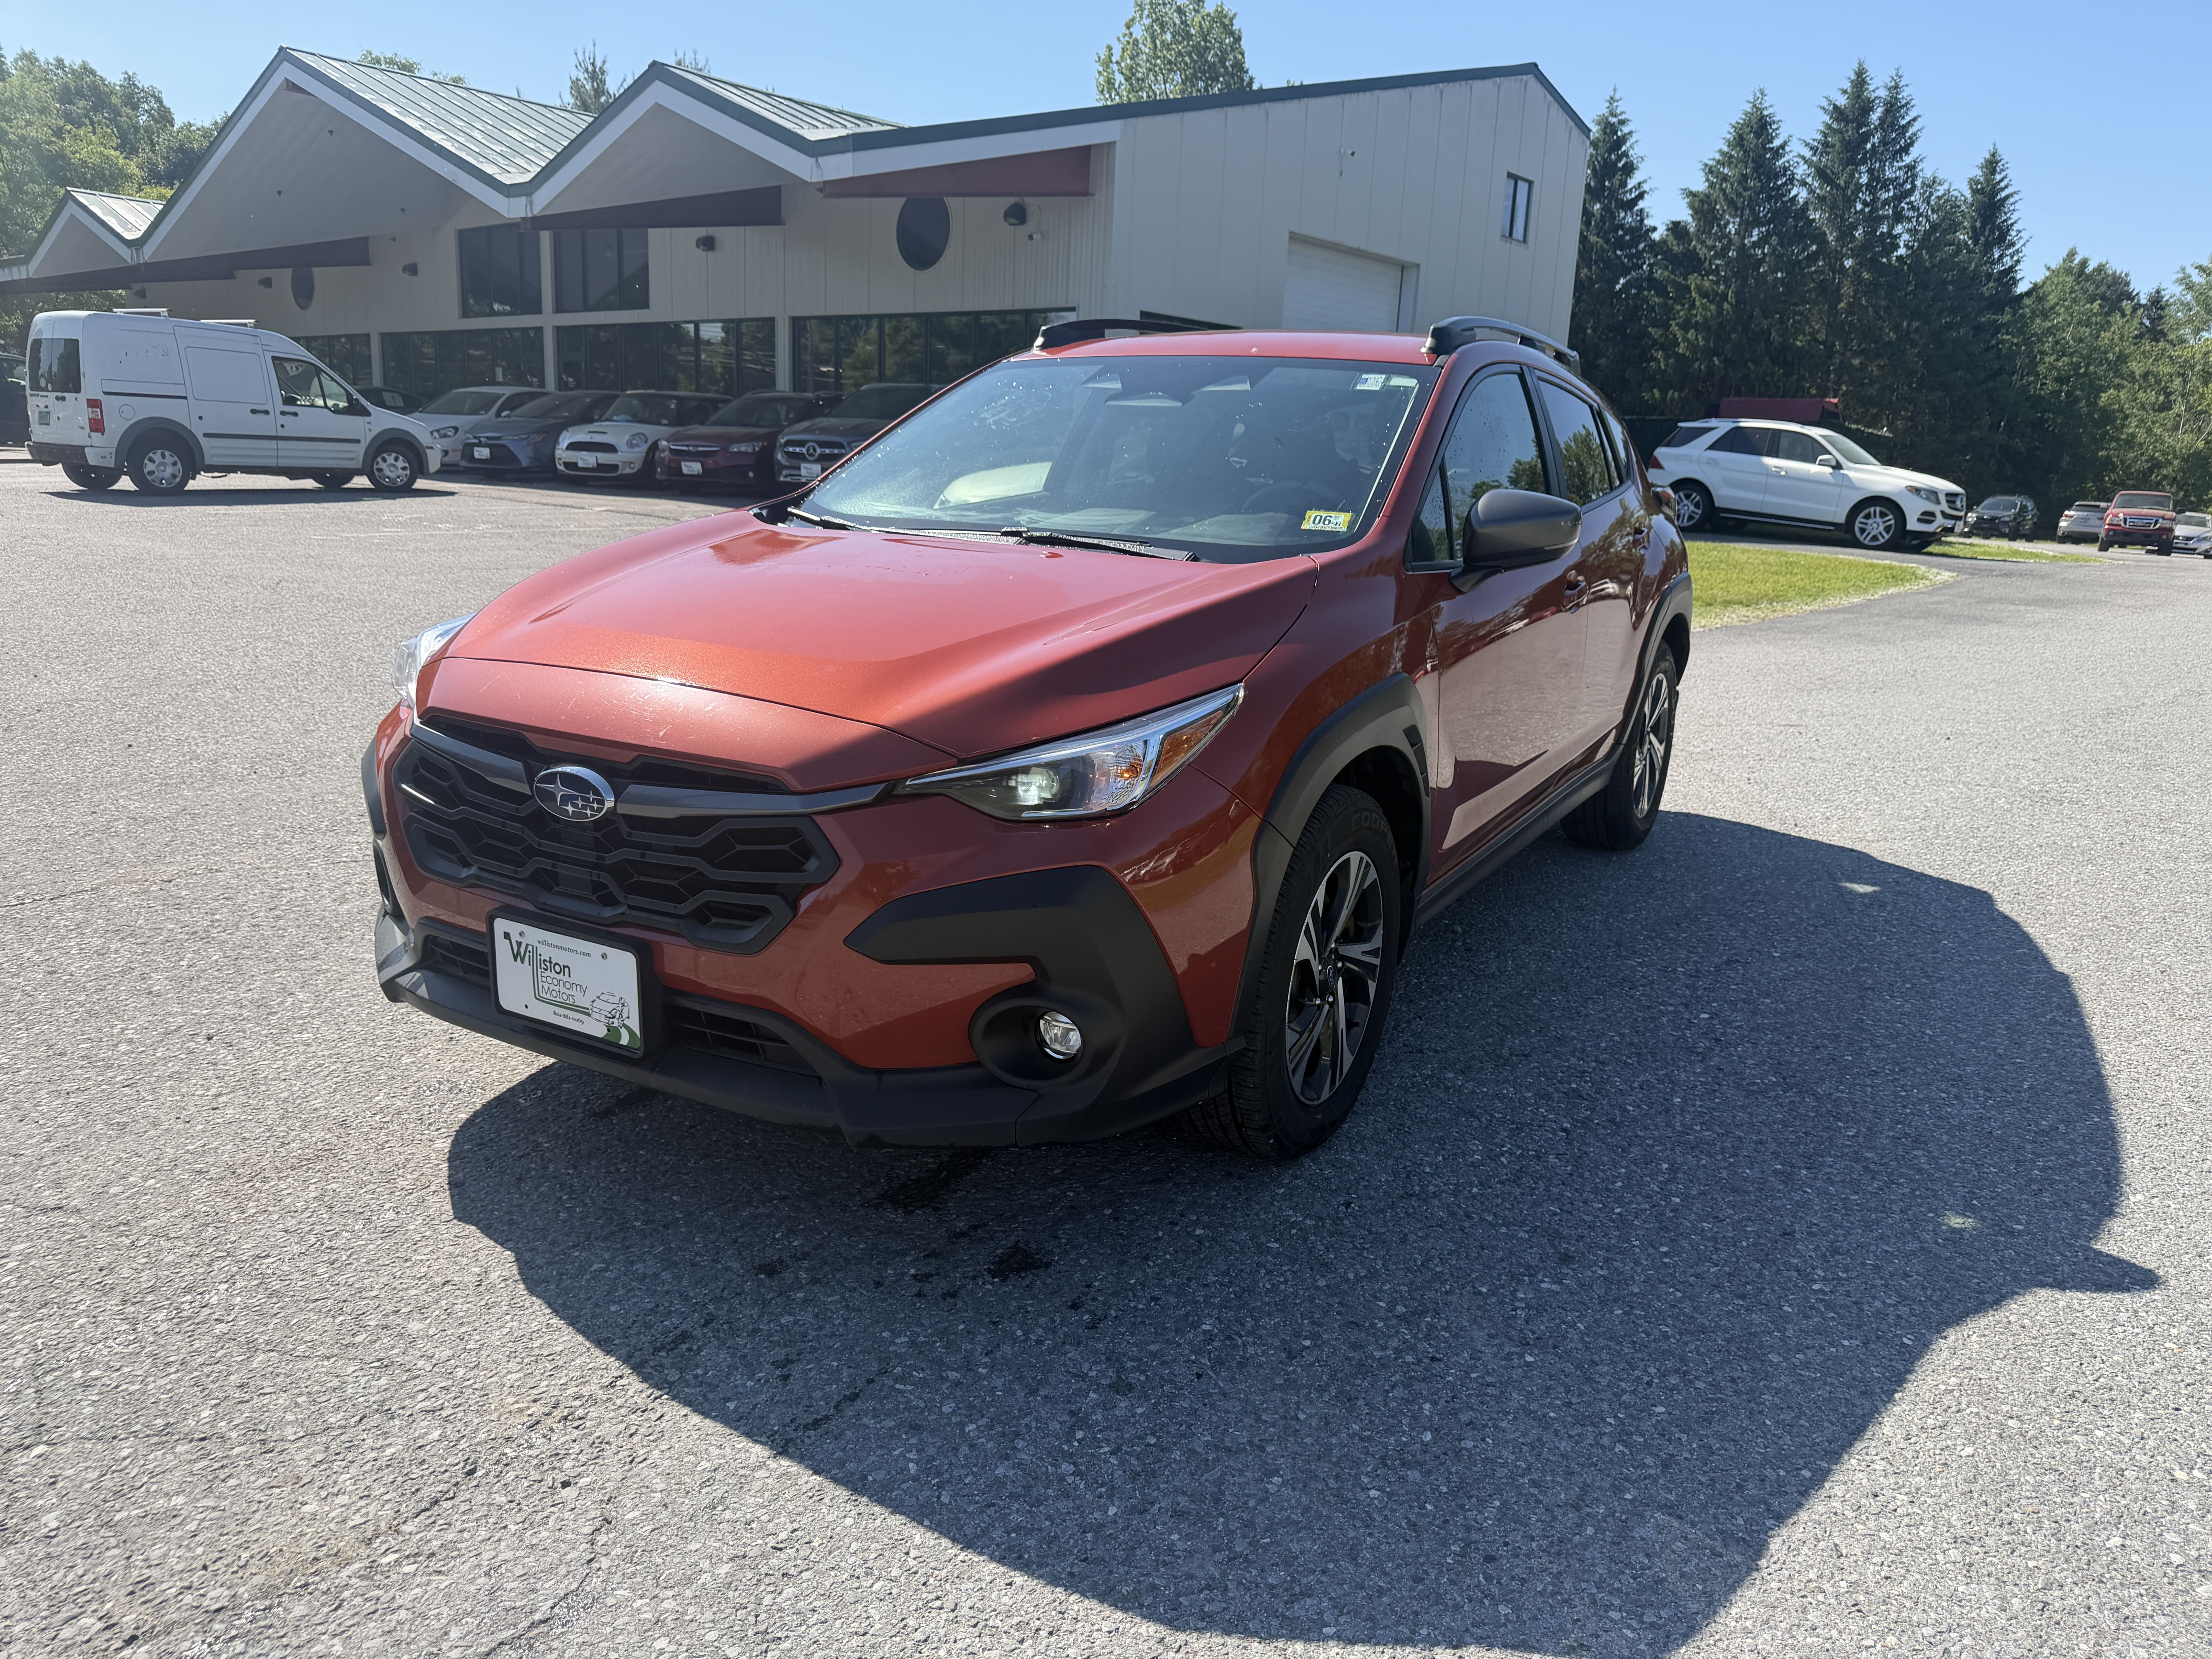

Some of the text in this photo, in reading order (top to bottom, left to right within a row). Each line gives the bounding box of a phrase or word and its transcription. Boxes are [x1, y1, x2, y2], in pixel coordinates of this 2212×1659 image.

[1312, 515, 1333, 526] 06
[503, 931, 571, 978] Williston
[537, 939, 591, 958] willistonmotors.com
[541, 971, 588, 997] Economy
[542, 984, 576, 1004] Motors
[553, 1010, 584, 1025] 802-881-0069
